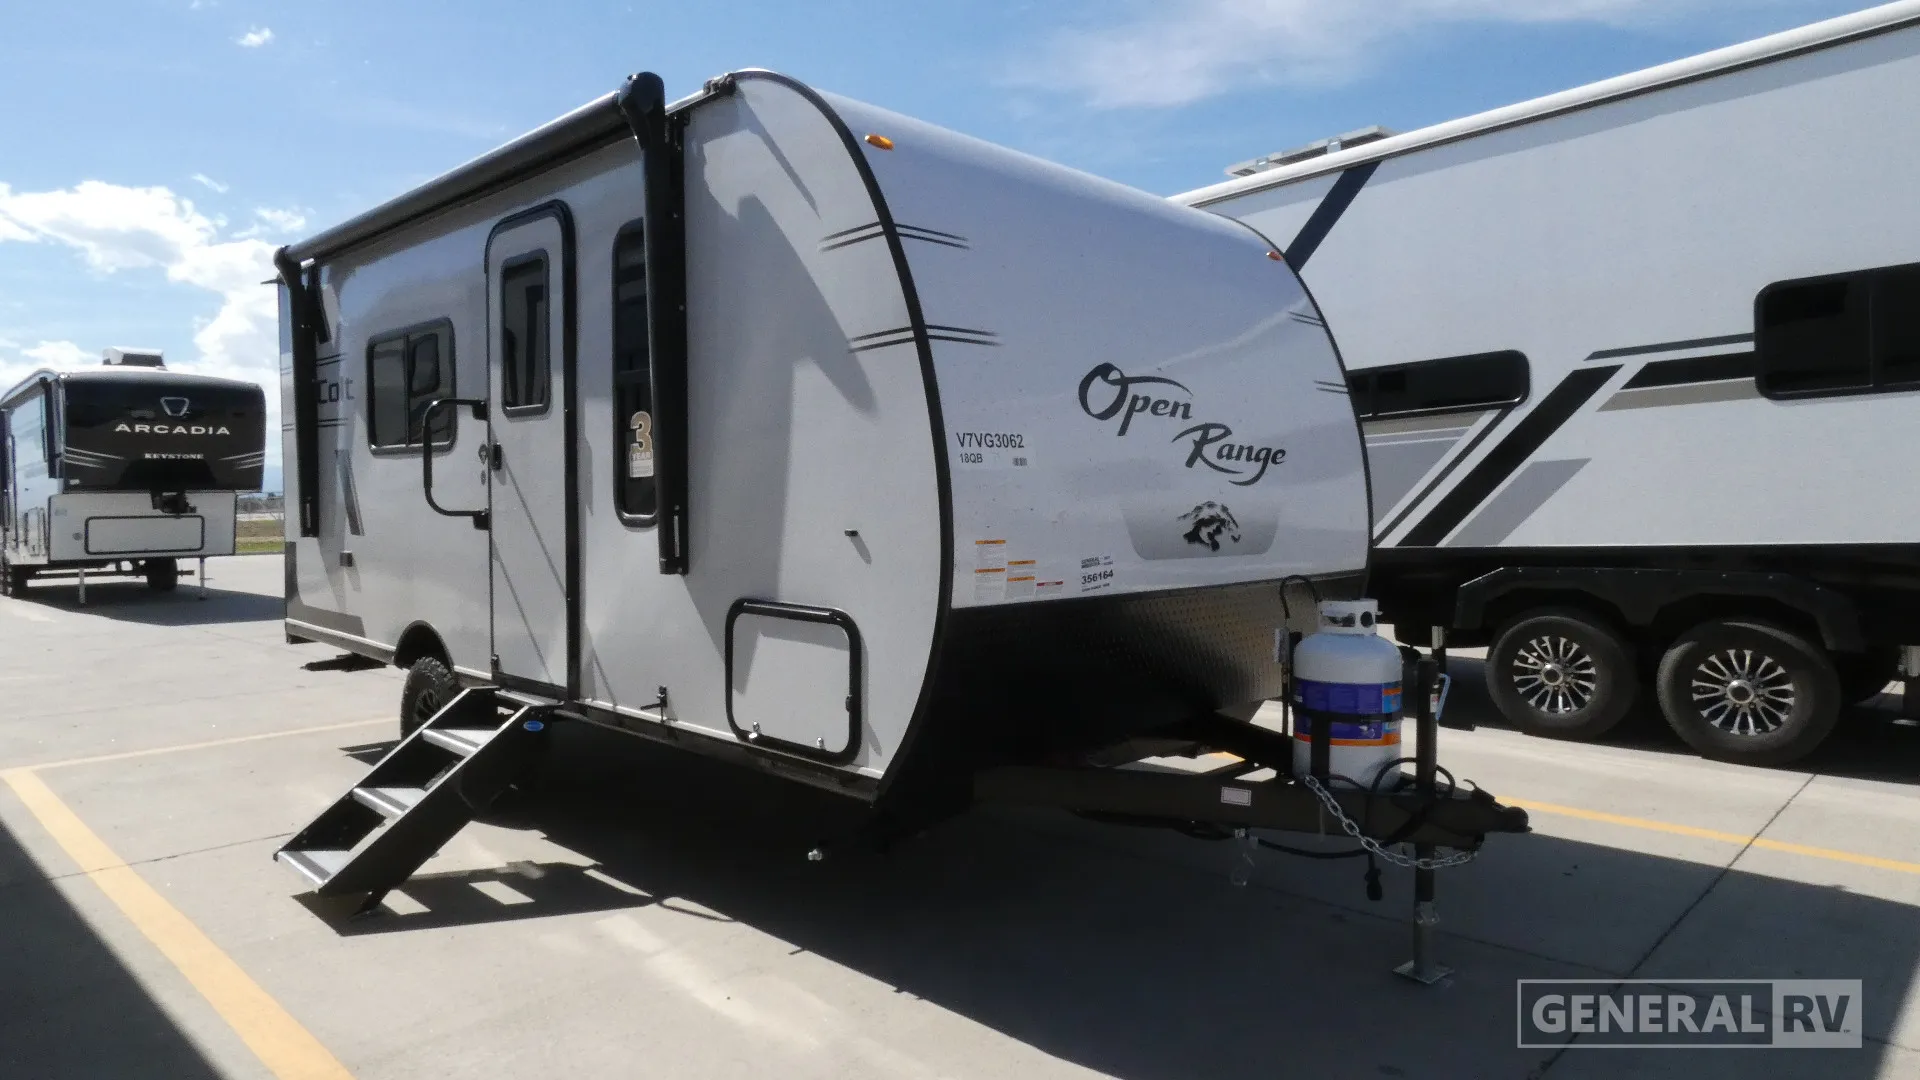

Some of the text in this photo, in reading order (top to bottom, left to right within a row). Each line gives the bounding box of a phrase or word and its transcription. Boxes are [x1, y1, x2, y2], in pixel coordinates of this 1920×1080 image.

[1078, 362, 1194, 437] Open
[115, 423, 231, 435] ARCADIA
[630, 410, 652, 453] 3
[956, 432, 1025, 448] V7VG3062
[959, 453, 983, 463] 18QB
[1171, 422, 1287, 486] Range
[1081, 568, 1114, 585] 356164
